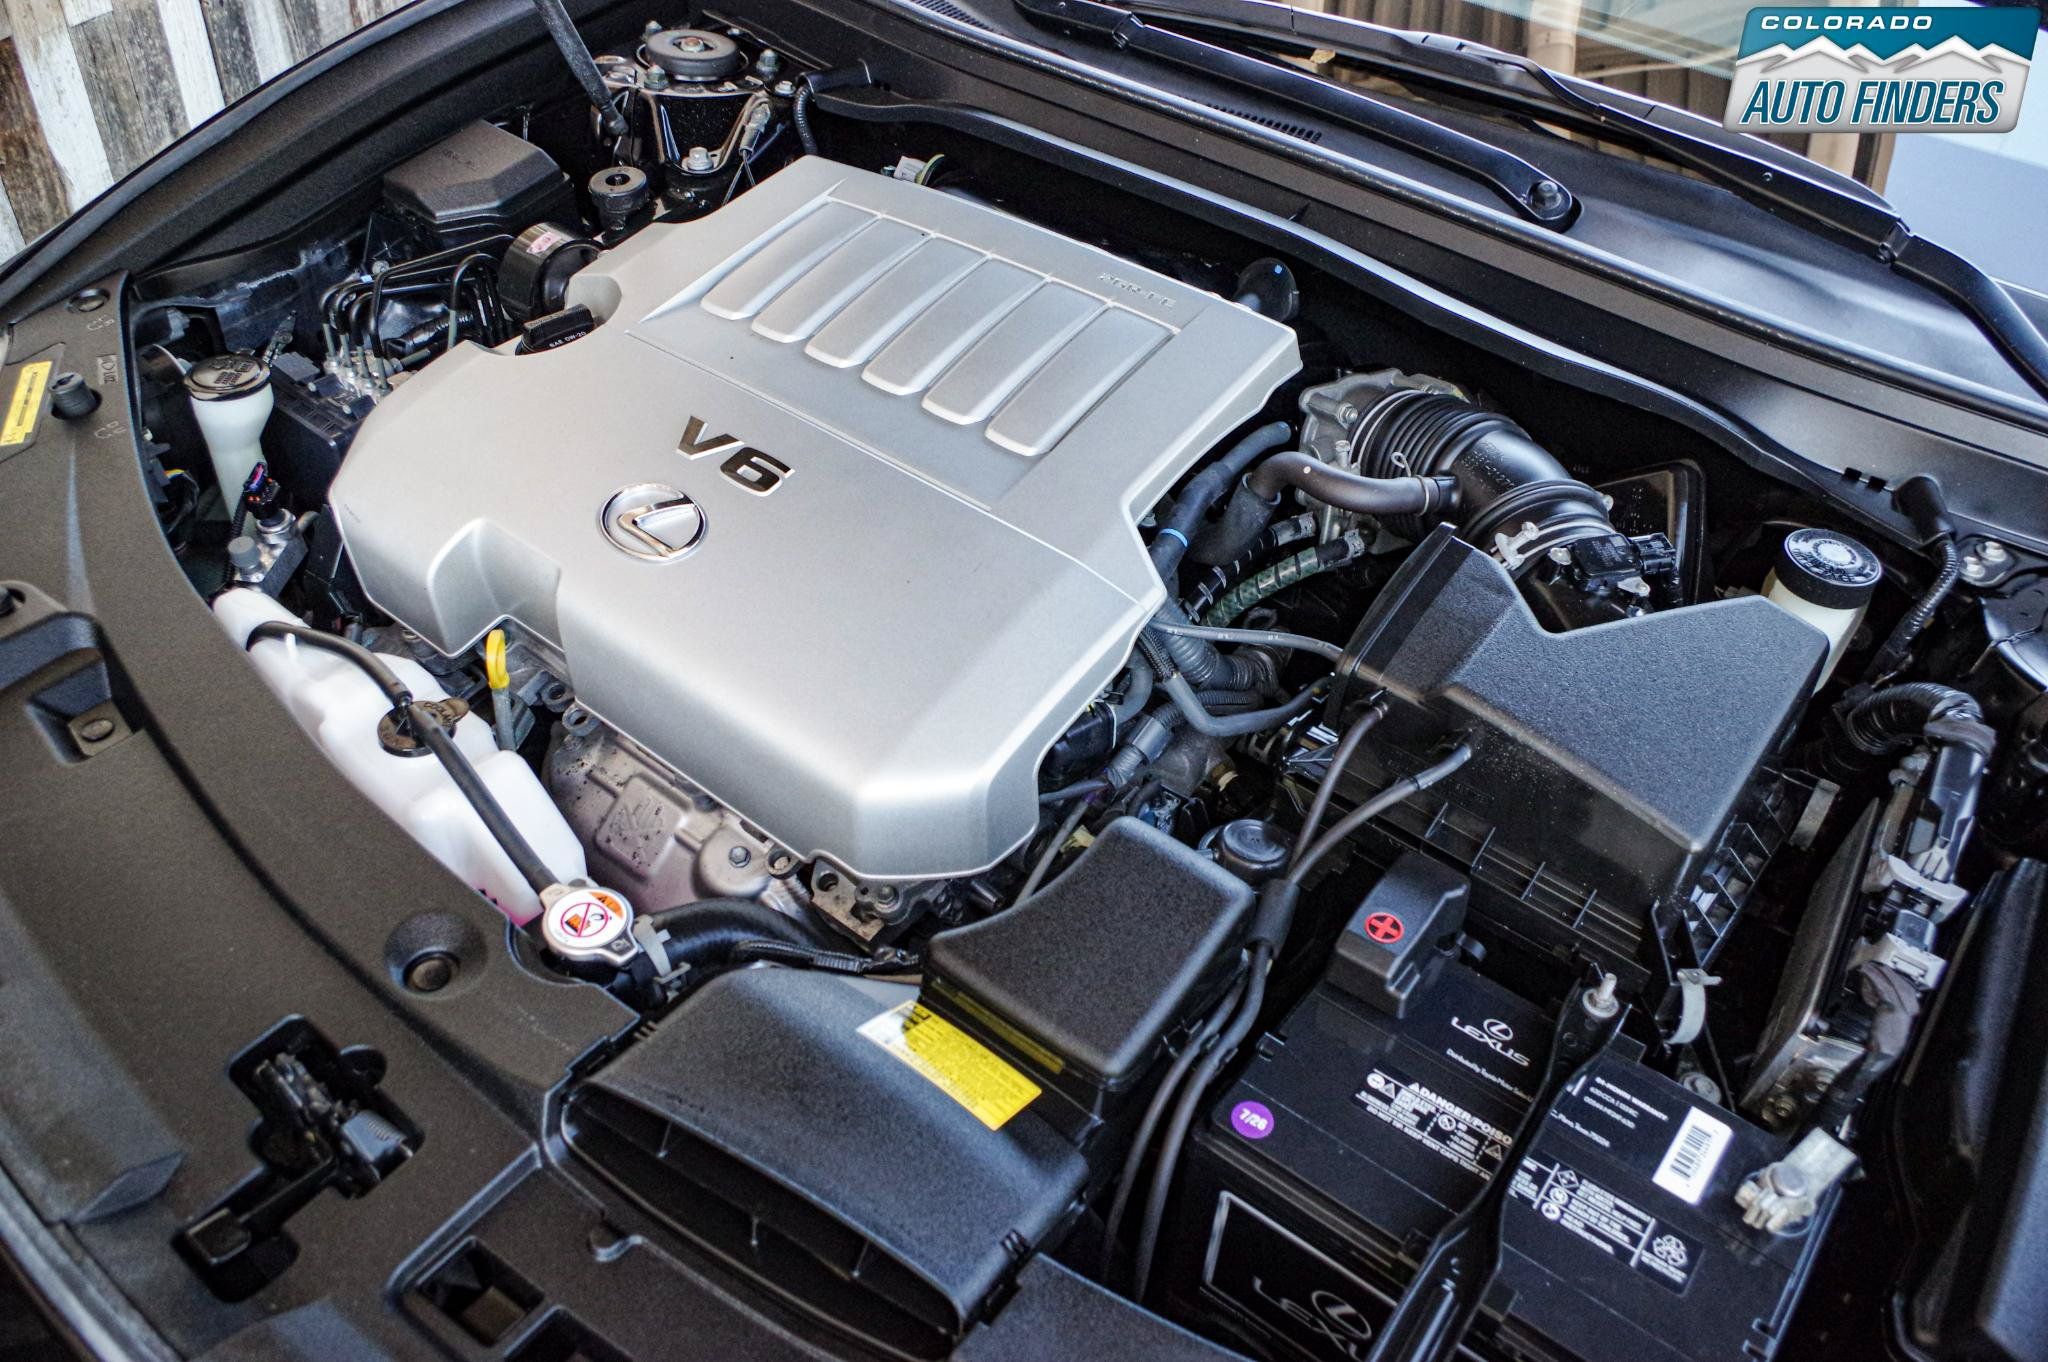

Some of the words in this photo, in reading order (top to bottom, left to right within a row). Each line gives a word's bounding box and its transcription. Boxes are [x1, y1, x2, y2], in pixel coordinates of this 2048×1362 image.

[549, 339, 564, 348] SAE
[676, 415, 796, 498] V6
[1450, 1016, 1531, 1067] LEXUS
[1418, 1085, 1514, 1147] DANGER/POISO
